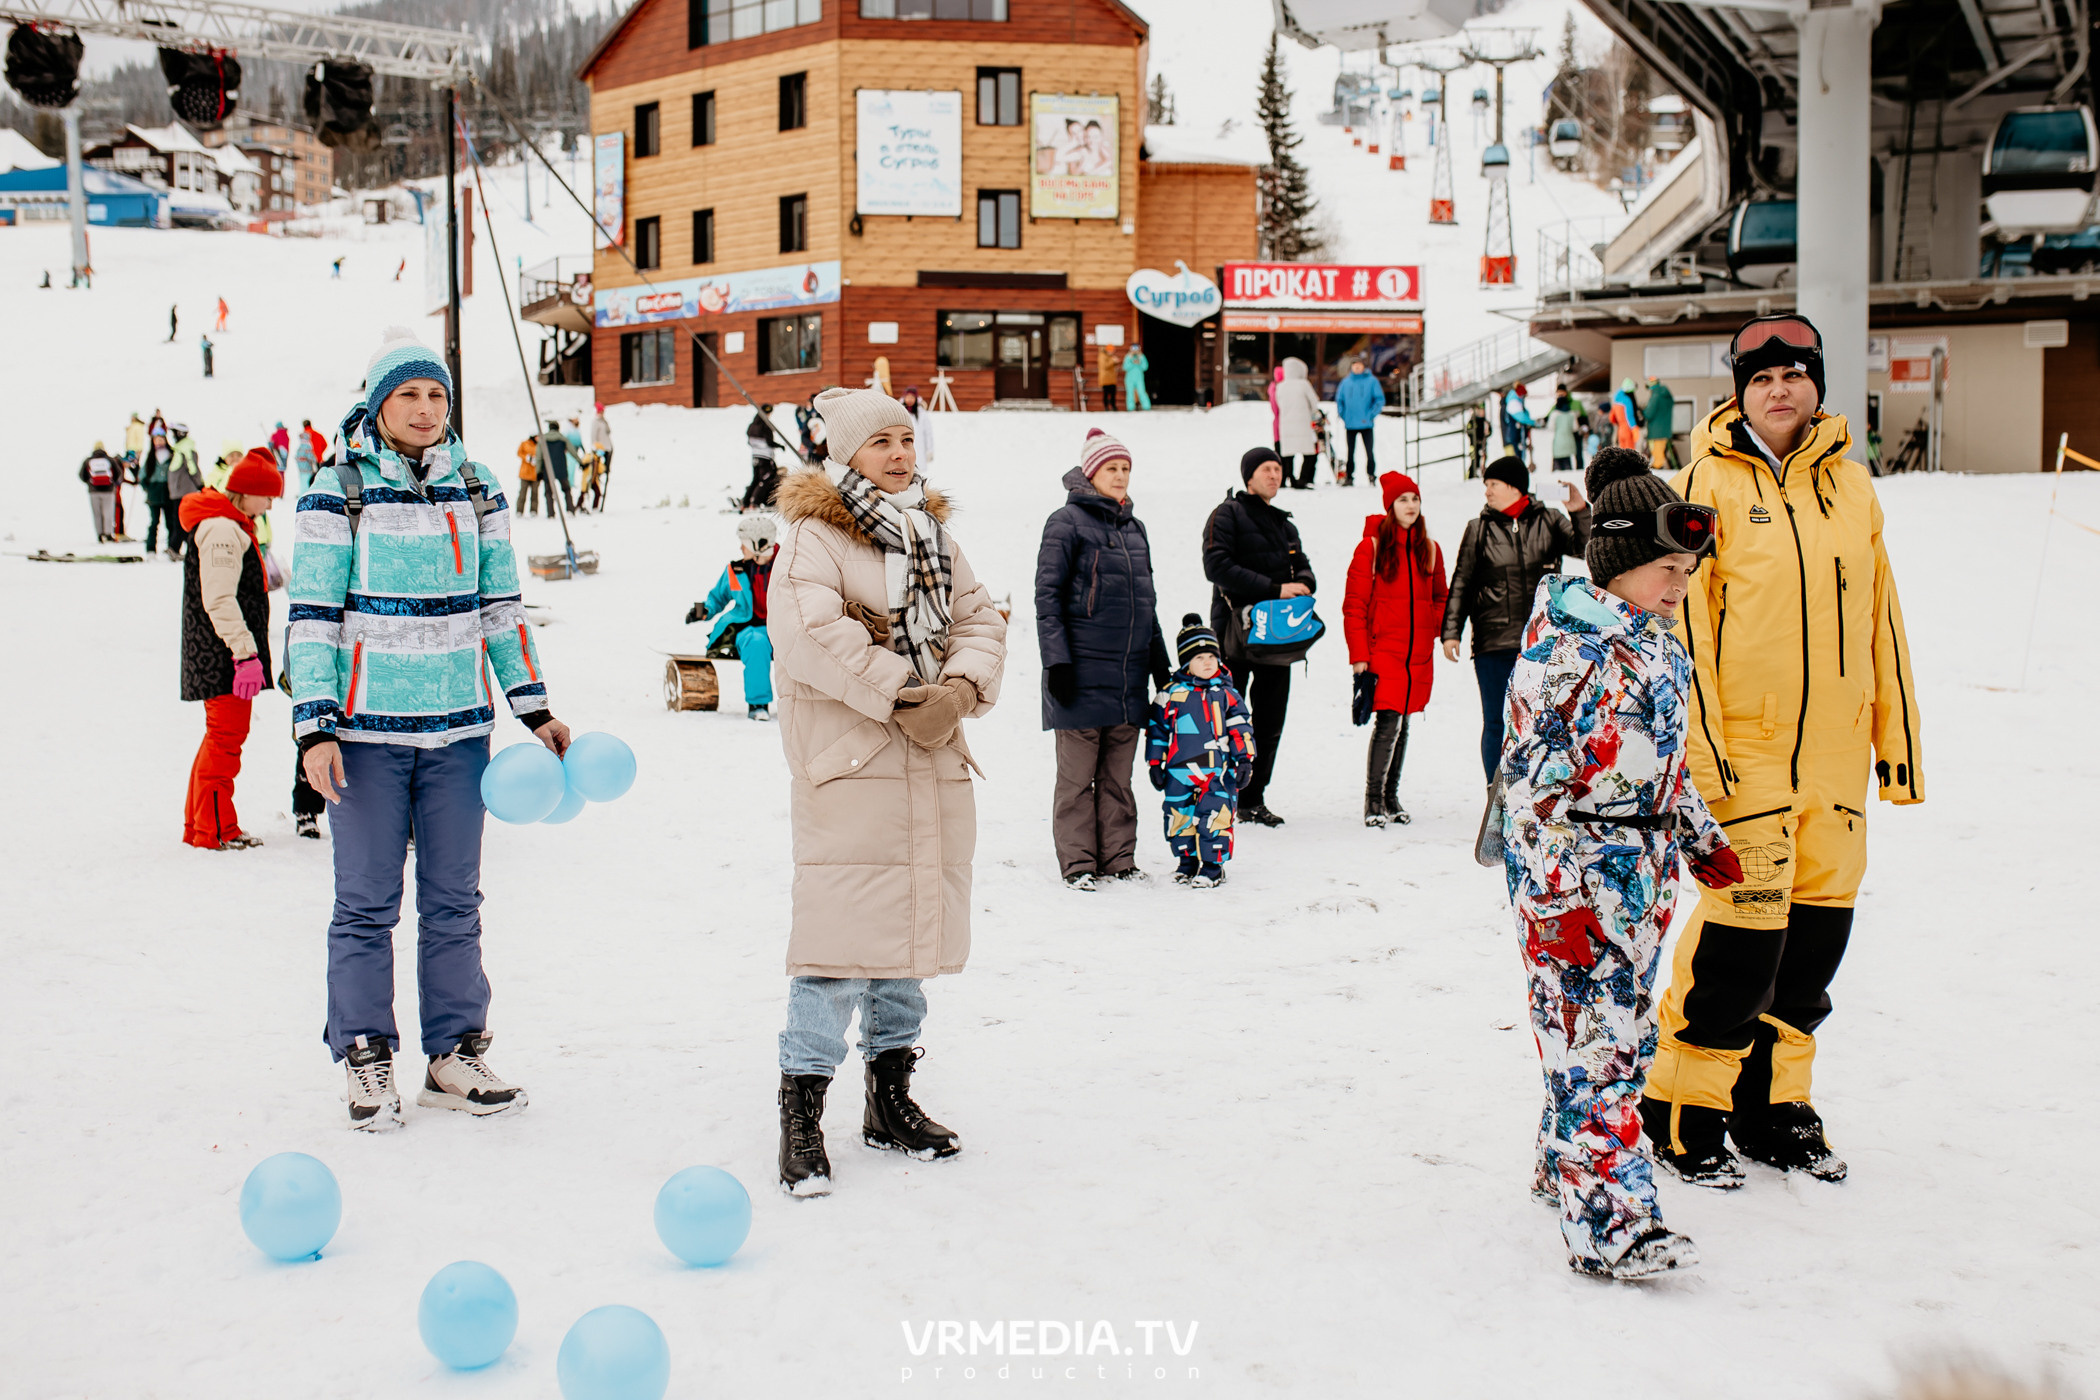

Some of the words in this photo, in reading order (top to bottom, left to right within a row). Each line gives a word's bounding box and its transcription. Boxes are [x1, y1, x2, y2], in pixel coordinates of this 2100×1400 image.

[888, 124, 931, 140] Туры
[880, 155, 939, 169] Сугроб
[1233, 268, 1339, 298] ПРОКАТ
[1352, 269, 1370, 297] #
[1134, 285, 1215, 308] Сугроб
[1255, 609, 1267, 640] NIKE
